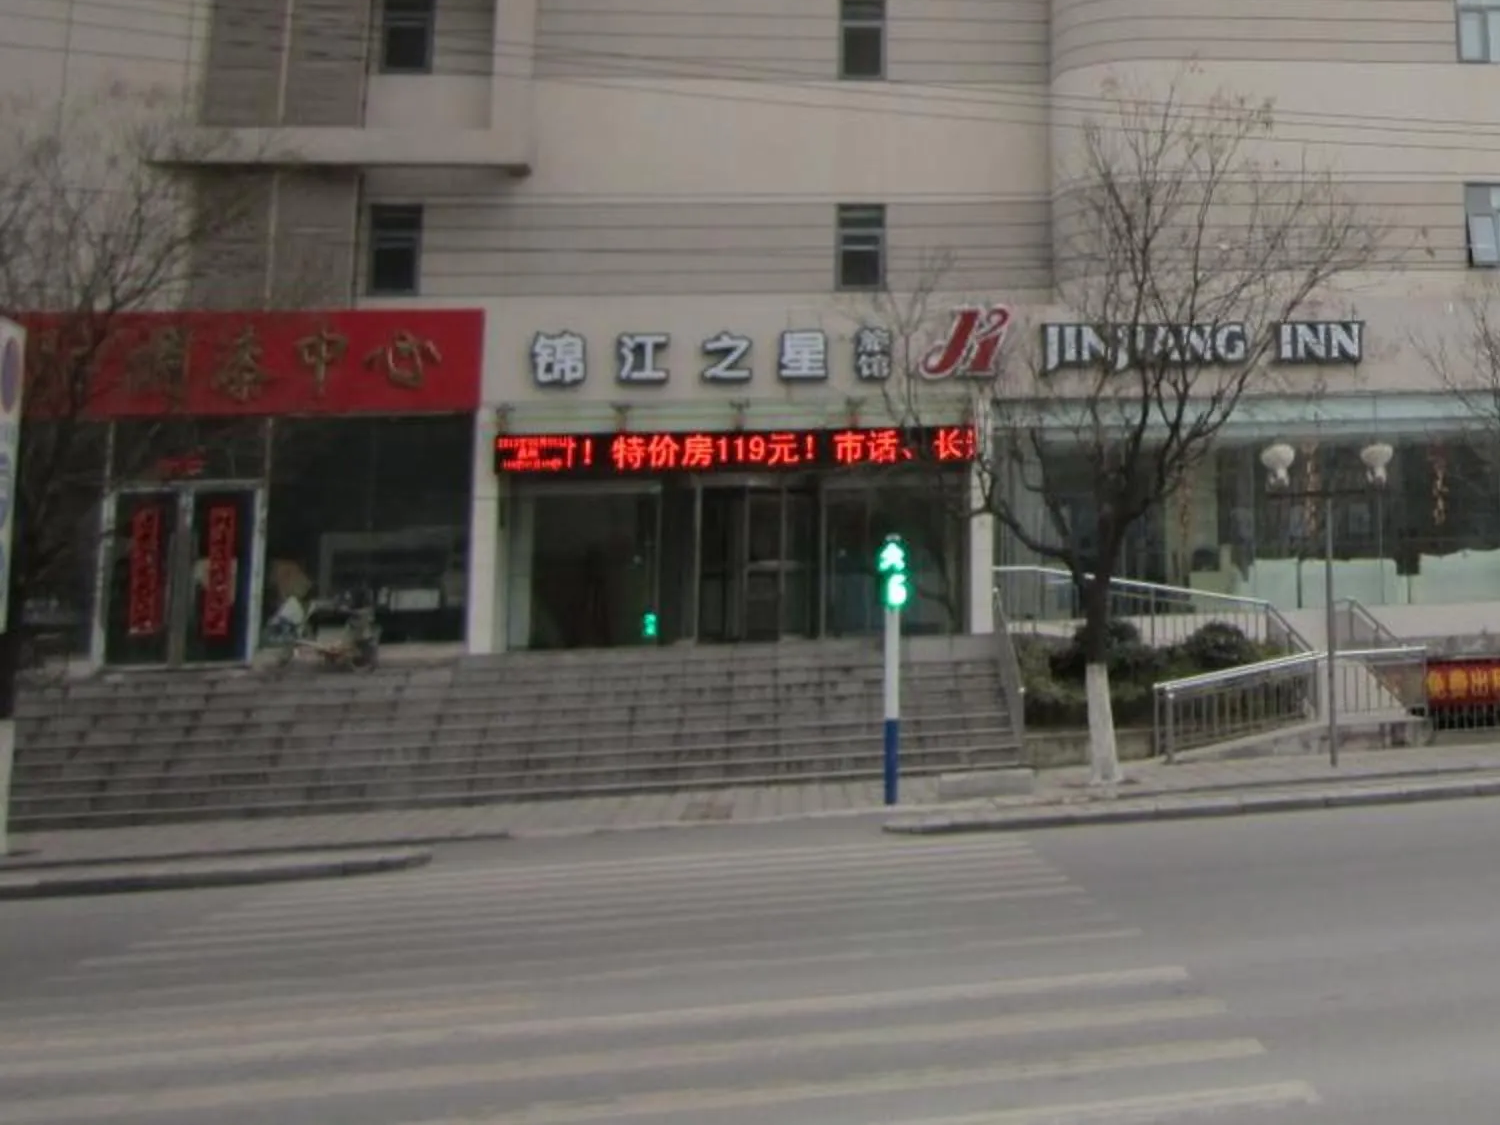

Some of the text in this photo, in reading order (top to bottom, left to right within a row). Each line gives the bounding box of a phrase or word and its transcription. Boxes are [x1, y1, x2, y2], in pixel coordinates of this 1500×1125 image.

[531, 326, 893, 384] 锦江之星 旅馆
[1277, 320, 1364, 362] INN
